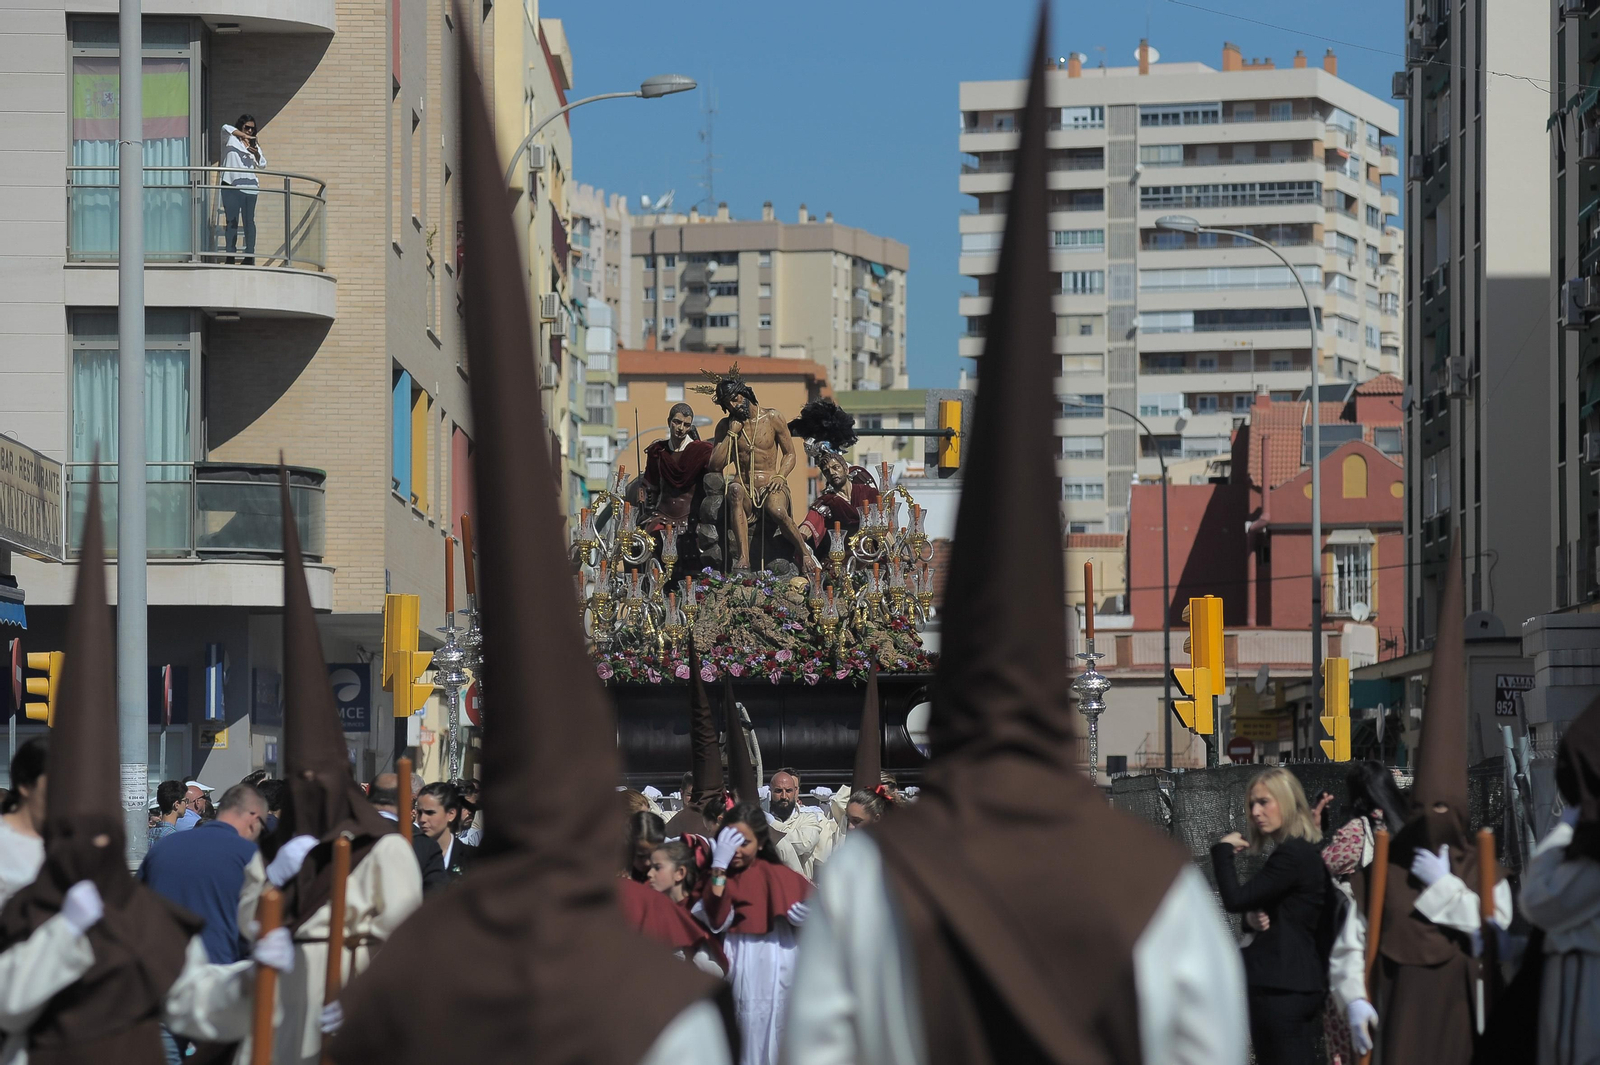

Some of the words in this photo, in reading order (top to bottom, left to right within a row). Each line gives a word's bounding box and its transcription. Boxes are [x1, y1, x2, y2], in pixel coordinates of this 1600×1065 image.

[1, 447, 13, 475] BAR
[19, 456, 59, 495] RESTAURANTE
[1497, 700, 1513, 715] 952
